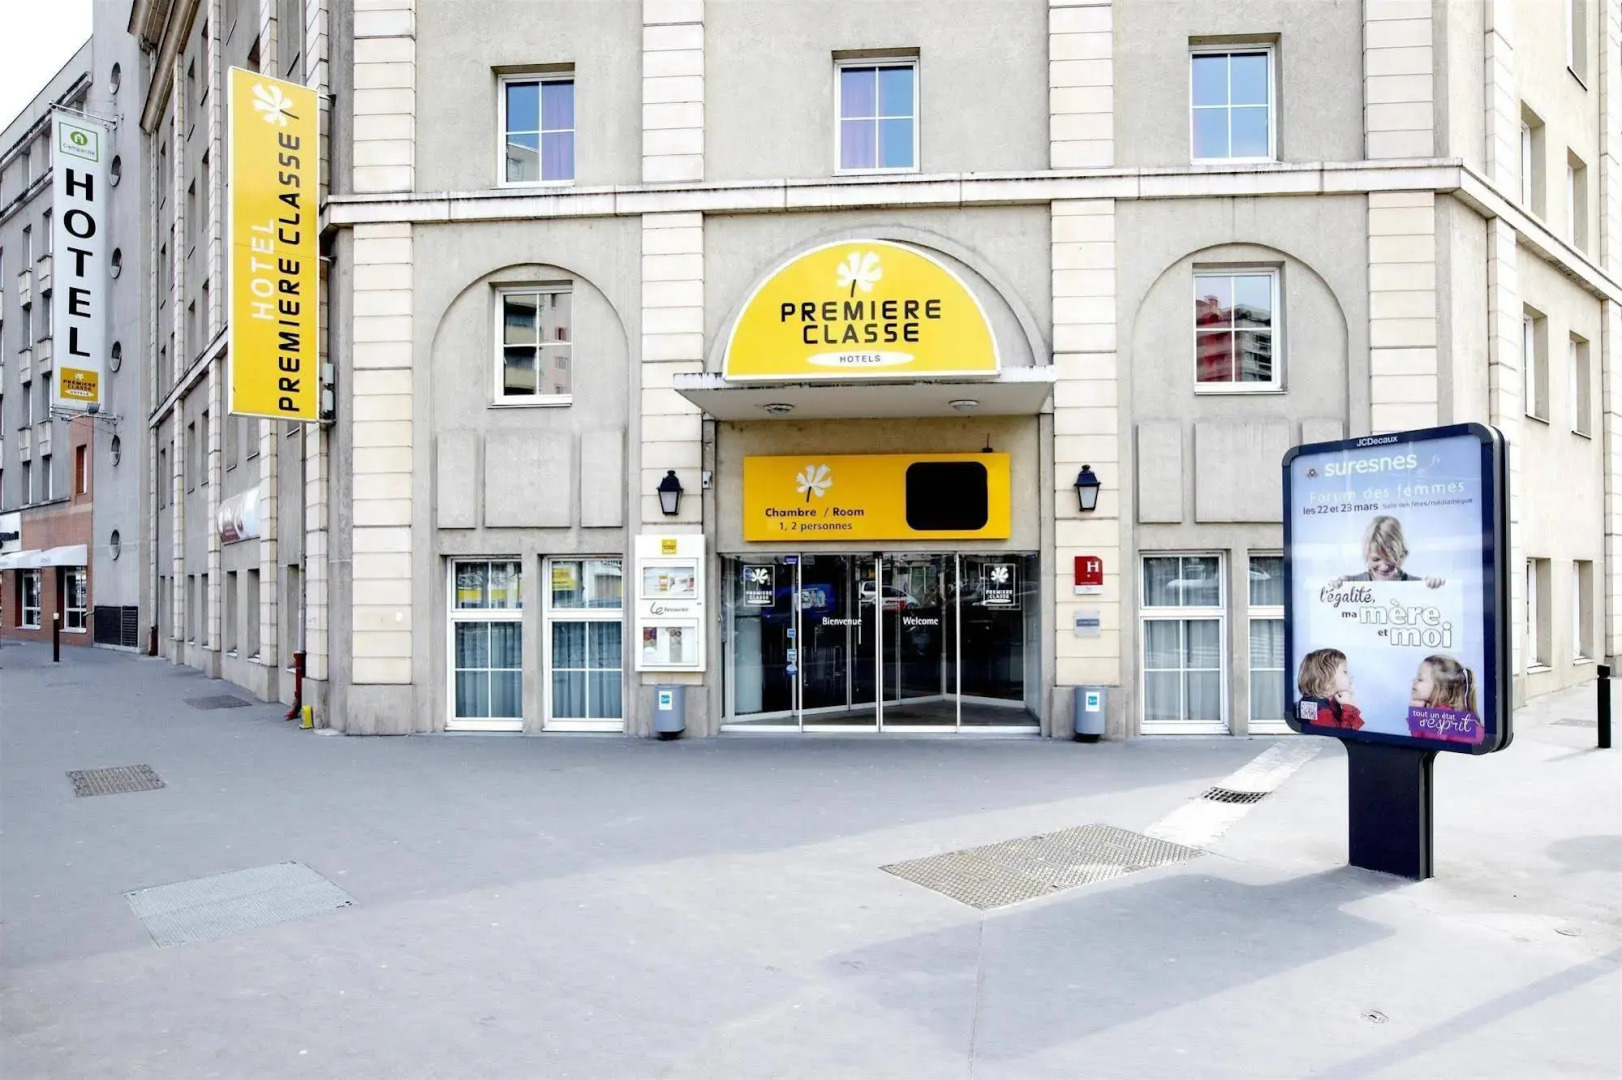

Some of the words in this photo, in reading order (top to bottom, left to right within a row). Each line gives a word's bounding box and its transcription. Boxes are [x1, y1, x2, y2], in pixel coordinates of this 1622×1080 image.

[279, 132, 300, 246] CLASSE
[63, 167, 96, 357] HOTEL
[251, 218, 274, 320] HOTEL
[781, 299, 941, 322] PREMIERE
[279, 257, 300, 412] PREMIERE
[803, 323, 919, 344] CLASSE
[839, 354, 881, 363] HOTELS
[62, 379, 96, 387] PREMIERE
[1356, 436, 1398, 447] JCDecaux
[1324, 453, 1417, 477] suresnes
[1309, 490, 1356, 504] Forum
[1363, 486, 1389, 500] des
[1397, 481, 1465, 497] femmes
[765, 507, 817, 517] Chambre
[833, 507, 864, 517] Room
[1303, 506, 1316, 515] les
[1317, 505, 1329, 514] 22
[1330, 505, 1339, 513] et
[1341, 503, 1352, 513] 23
[1354, 502, 1379, 512] mars
[791, 522, 797, 530] 2
[800, 523, 853, 532] personnes
[1086, 561, 1100, 573] H
[650, 601, 664, 616] Le
[1341, 610, 1357, 619] ma
[1359, 598, 1441, 626] mère
[822, 616, 863, 626] Bienvenue
[903, 616, 939, 626] Welcome
[1377, 628, 1388, 637] et
[1390, 621, 1452, 648] moi
[1413, 710, 1428, 718] tout
[1441, 712, 1456, 721] état
[1419, 713, 1478, 735] d'esprit
